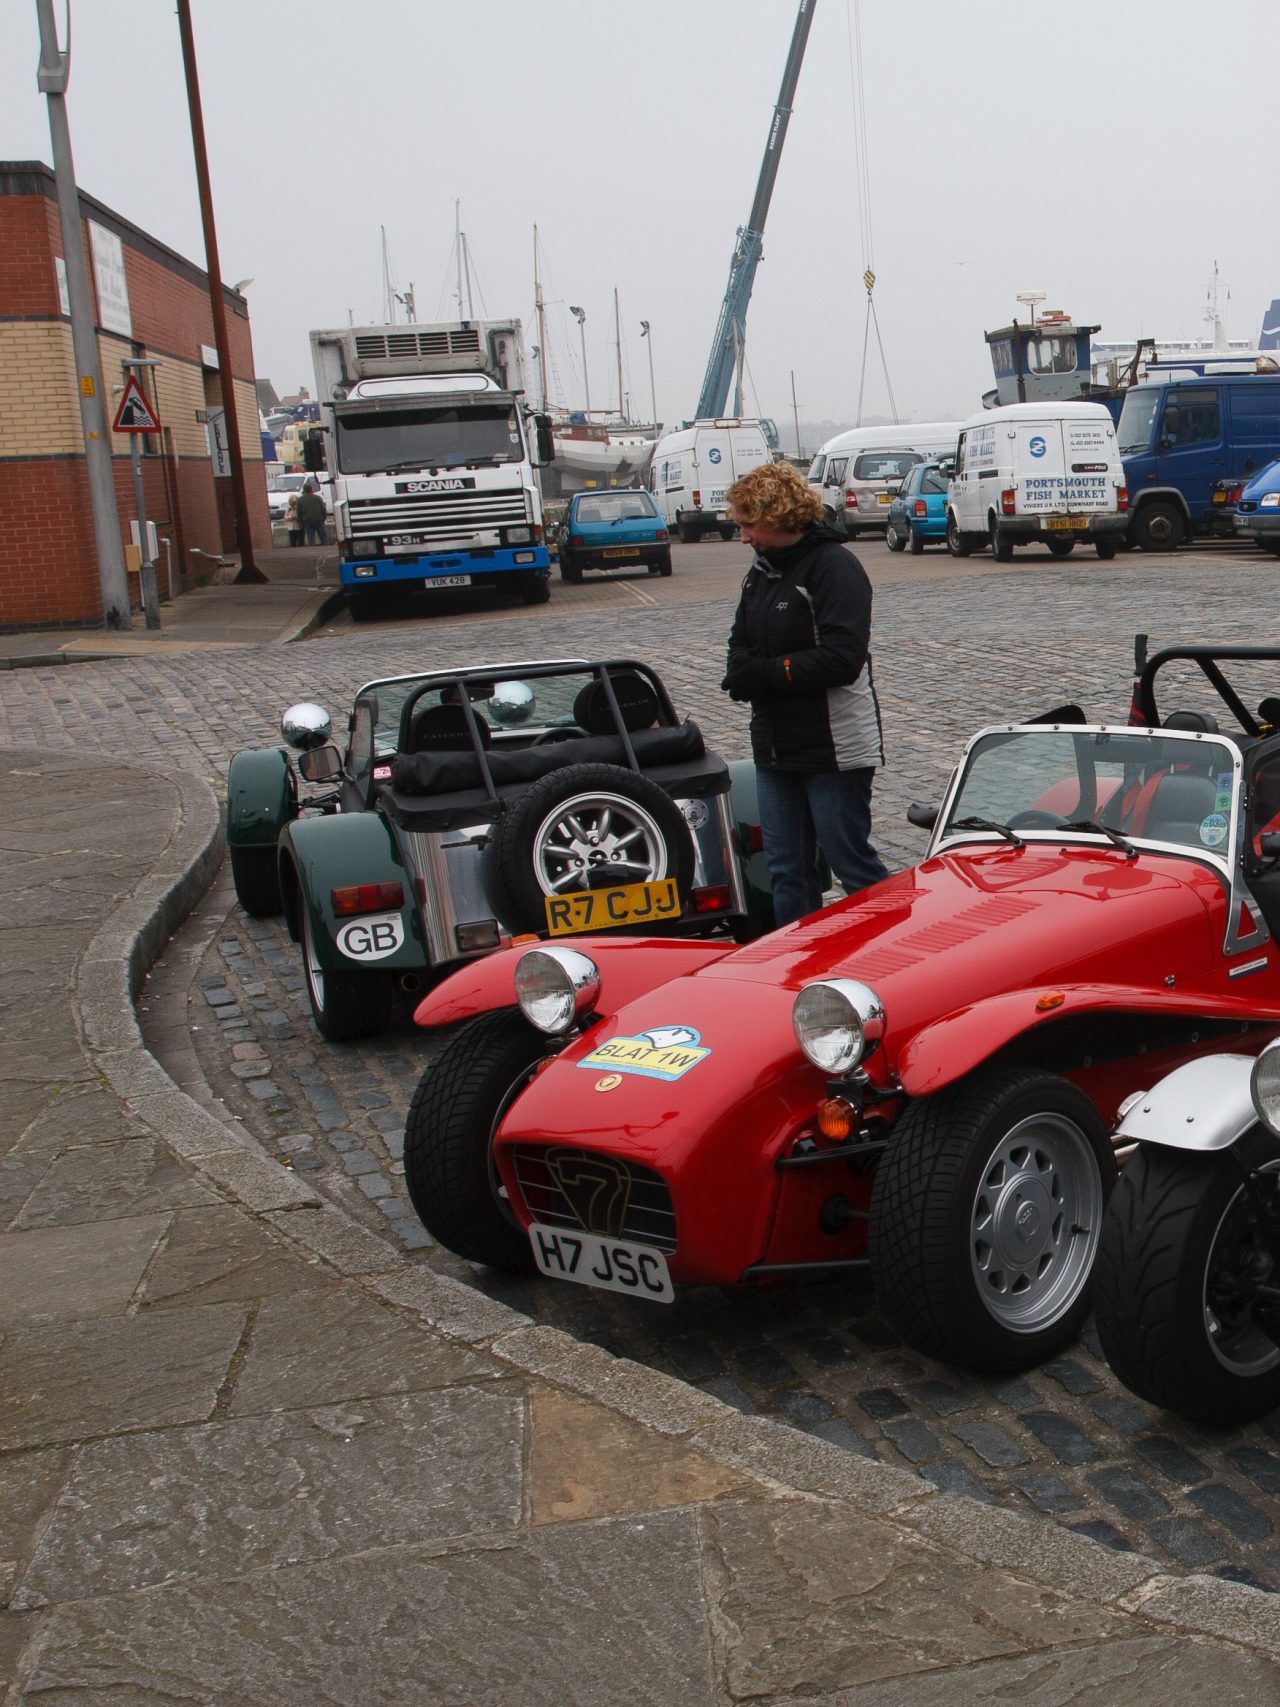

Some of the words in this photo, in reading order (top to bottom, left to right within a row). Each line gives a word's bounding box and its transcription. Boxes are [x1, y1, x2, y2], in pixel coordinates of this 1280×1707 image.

[407, 479, 465, 493] SCANIA
[1026, 478, 1106, 489] PORTSMOUTH
[1026, 491, 1052, 501] FISH
[1059, 490, 1107, 499] MARKET
[432, 578, 449, 586] VUK
[549, 896, 594, 929] R7
[606, 884, 676, 920] CJJ
[344, 923, 398, 955] GB
[596, 1045, 659, 1061] BLAT
[659, 1052, 698, 1068] 1W
[557, 1157, 622, 1235] 7
[536, 1231, 583, 1274] H7
[592, 1245, 664, 1293] JSC
